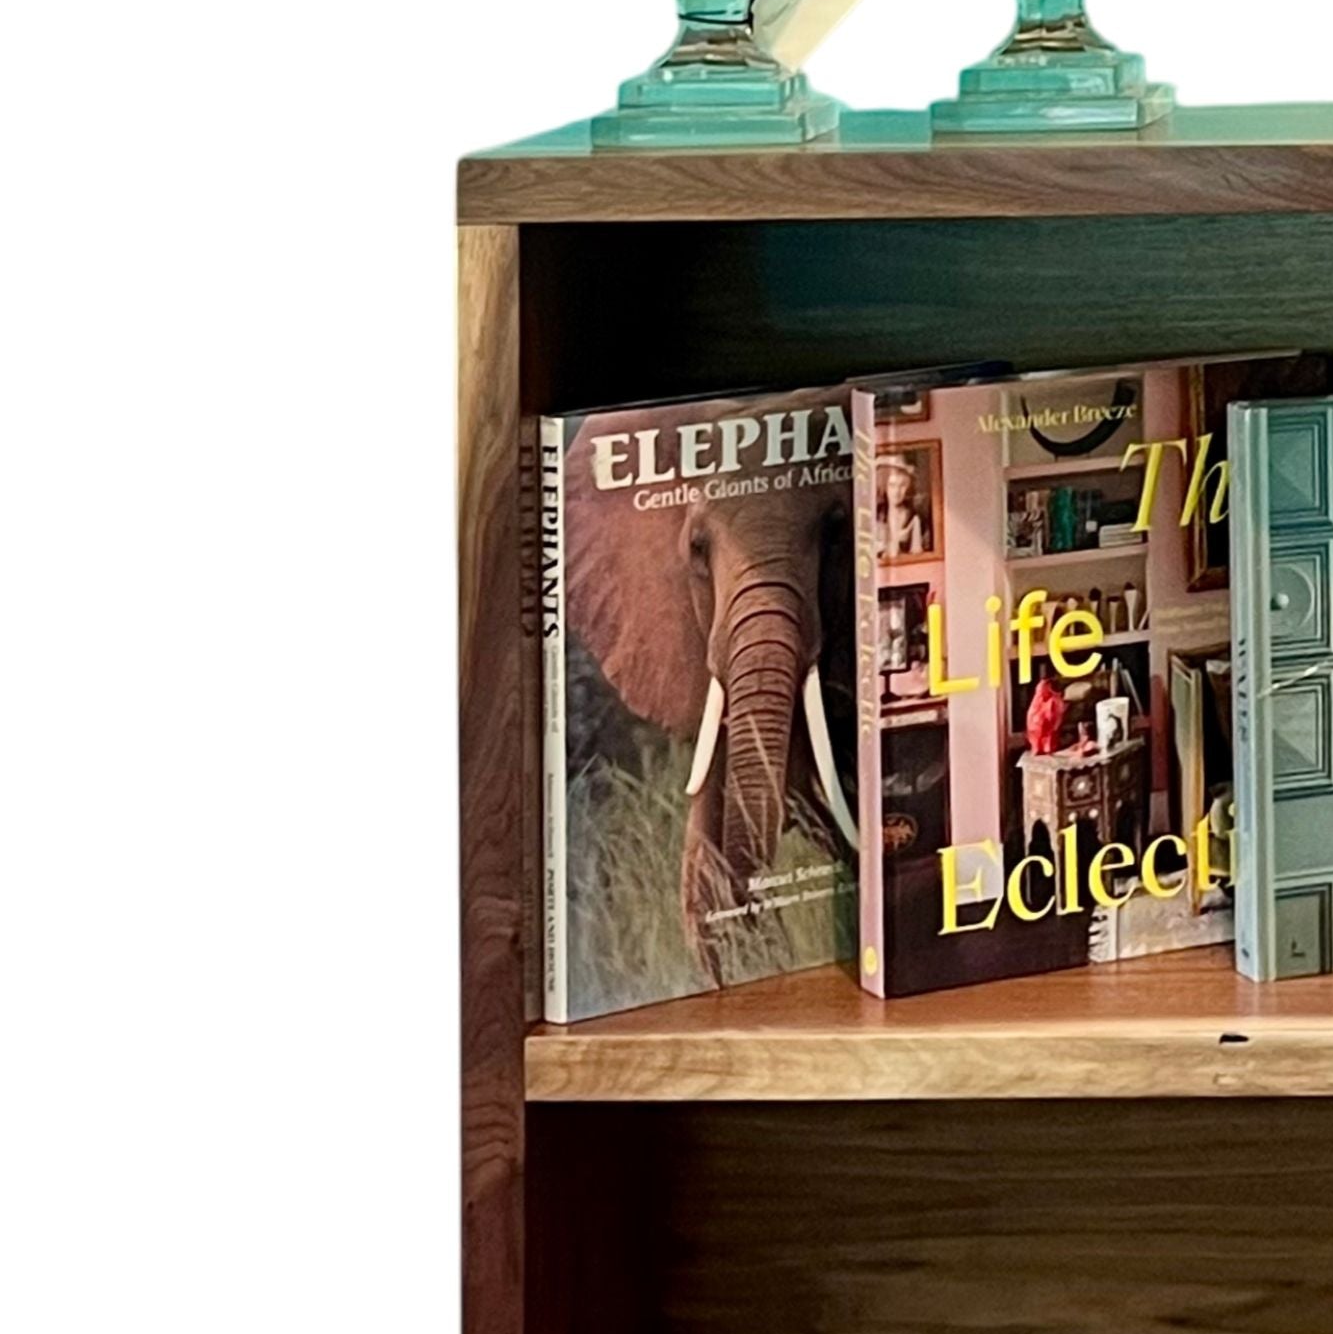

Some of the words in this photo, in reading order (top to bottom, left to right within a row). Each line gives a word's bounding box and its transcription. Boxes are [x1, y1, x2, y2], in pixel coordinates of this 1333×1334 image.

[977, 406, 1069, 434] Alexander
[1073, 402, 1138, 424] Breeze
[632, 481, 700, 512] Gentle
[703, 474, 769, 500] Giants
[773, 470, 793, 490] of
[541, 445, 560, 639] ELEPHANTS
[927, 590, 1104, 697] Life
